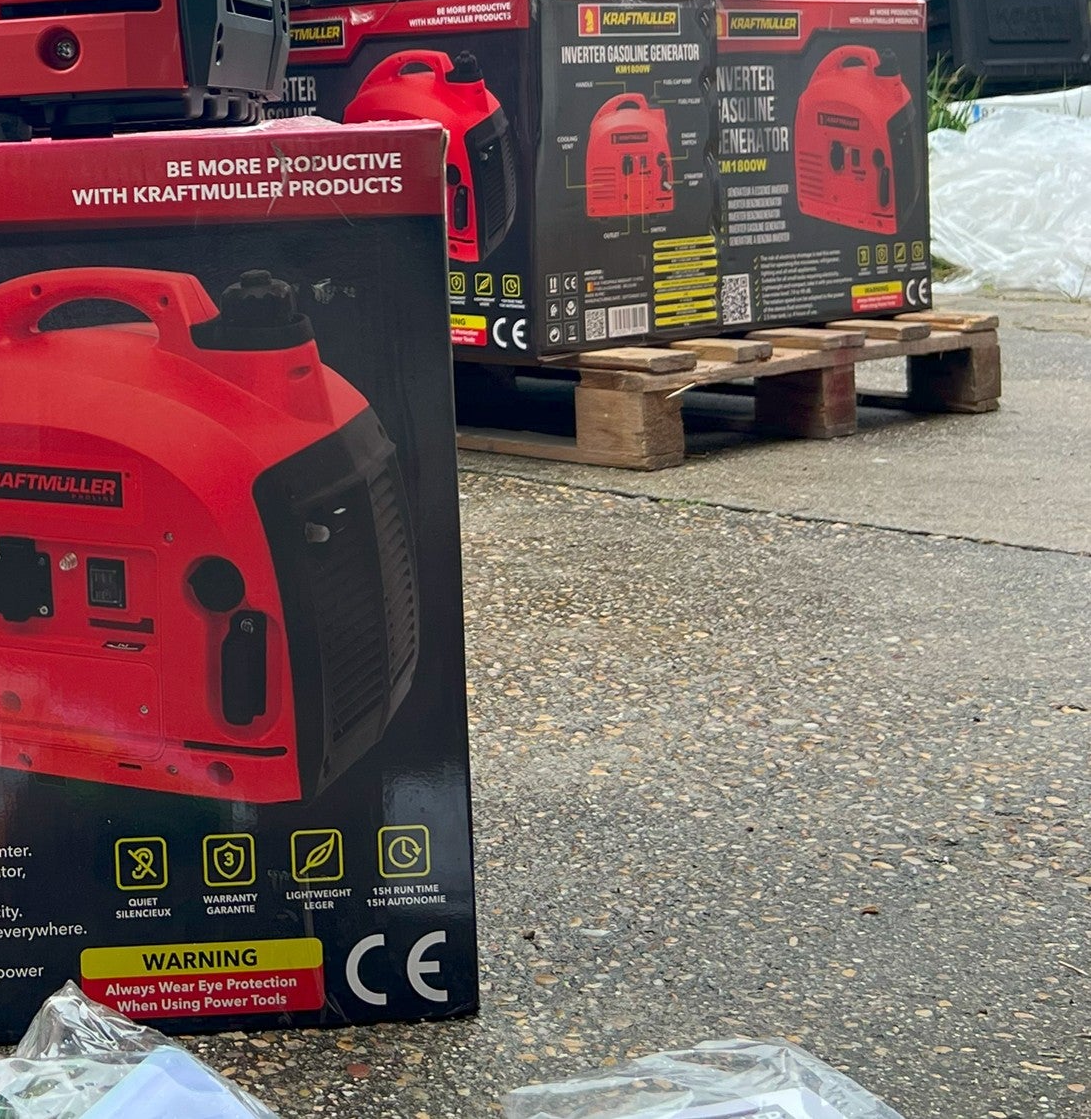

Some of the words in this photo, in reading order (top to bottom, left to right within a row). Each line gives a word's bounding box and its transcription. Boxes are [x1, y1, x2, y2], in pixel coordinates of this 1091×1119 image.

[562, 46, 605, 63] INVERTER
[608, 45, 649, 62] GASOLINE
[651, 44, 699, 61] GENERATOR
[167, 161, 192, 177] BE
[199, 158, 261, 176] MORE
[267, 153, 401, 175] PRODUCTIVE
[72, 188, 127, 205] WITH
[134, 179, 285, 203] KRAFTMULLER
[289, 177, 402, 196] PRODUCTS
[286, 888, 351, 900] LIGHTWEIGHT
[372, 886, 391, 895] 15H
[392, 885, 414, 894] RUN
[416, 884, 439, 893] TIME
[128, 898, 158, 908] QUIET
[203, 893, 258, 904] WARRANTY
[366, 897, 386, 907] 15H
[388, 894, 446, 906] AUTONOMIE
[206, 904, 256, 915] GARANTIE
[304, 900, 334, 910] LEGER
[116, 908, 171, 919] SILENCIEUX
[142, 948, 258, 971] WARNING
[106, 982, 156, 997] Always
[158, 980, 195, 993] Wear
[198, 980, 223, 993] Eye
[226, 976, 297, 989] Protection
[117, 999, 159, 1013] When
[161, 997, 201, 1011] Using
[204, 995, 248, 1009] Power
[252, 993, 287, 1006] Tools
